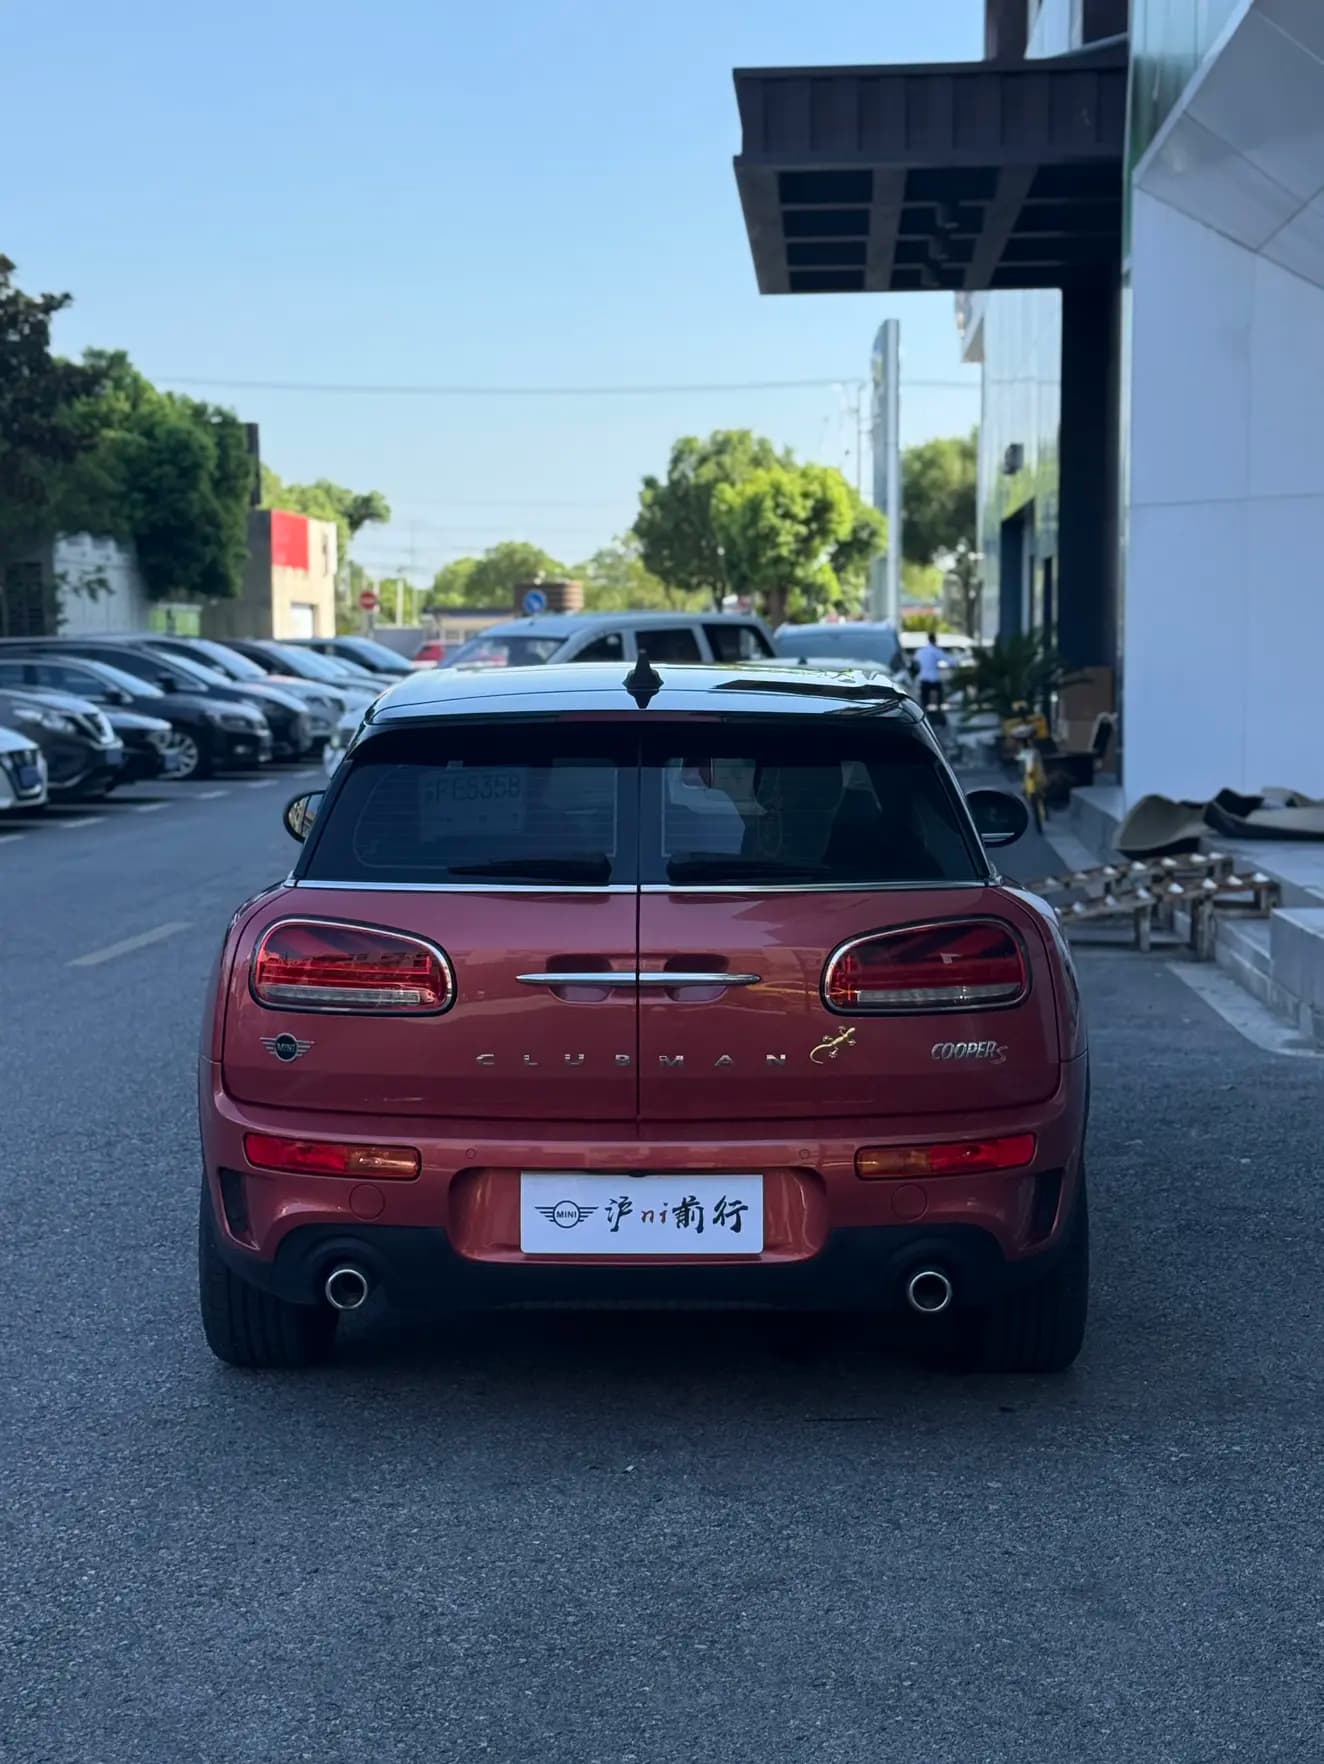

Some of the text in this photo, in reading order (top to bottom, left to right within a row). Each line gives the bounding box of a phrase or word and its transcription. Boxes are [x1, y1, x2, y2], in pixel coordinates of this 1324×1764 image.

[930, 1041, 1009, 1065] COOPER S
[556, 1210, 578, 1218] MINI
